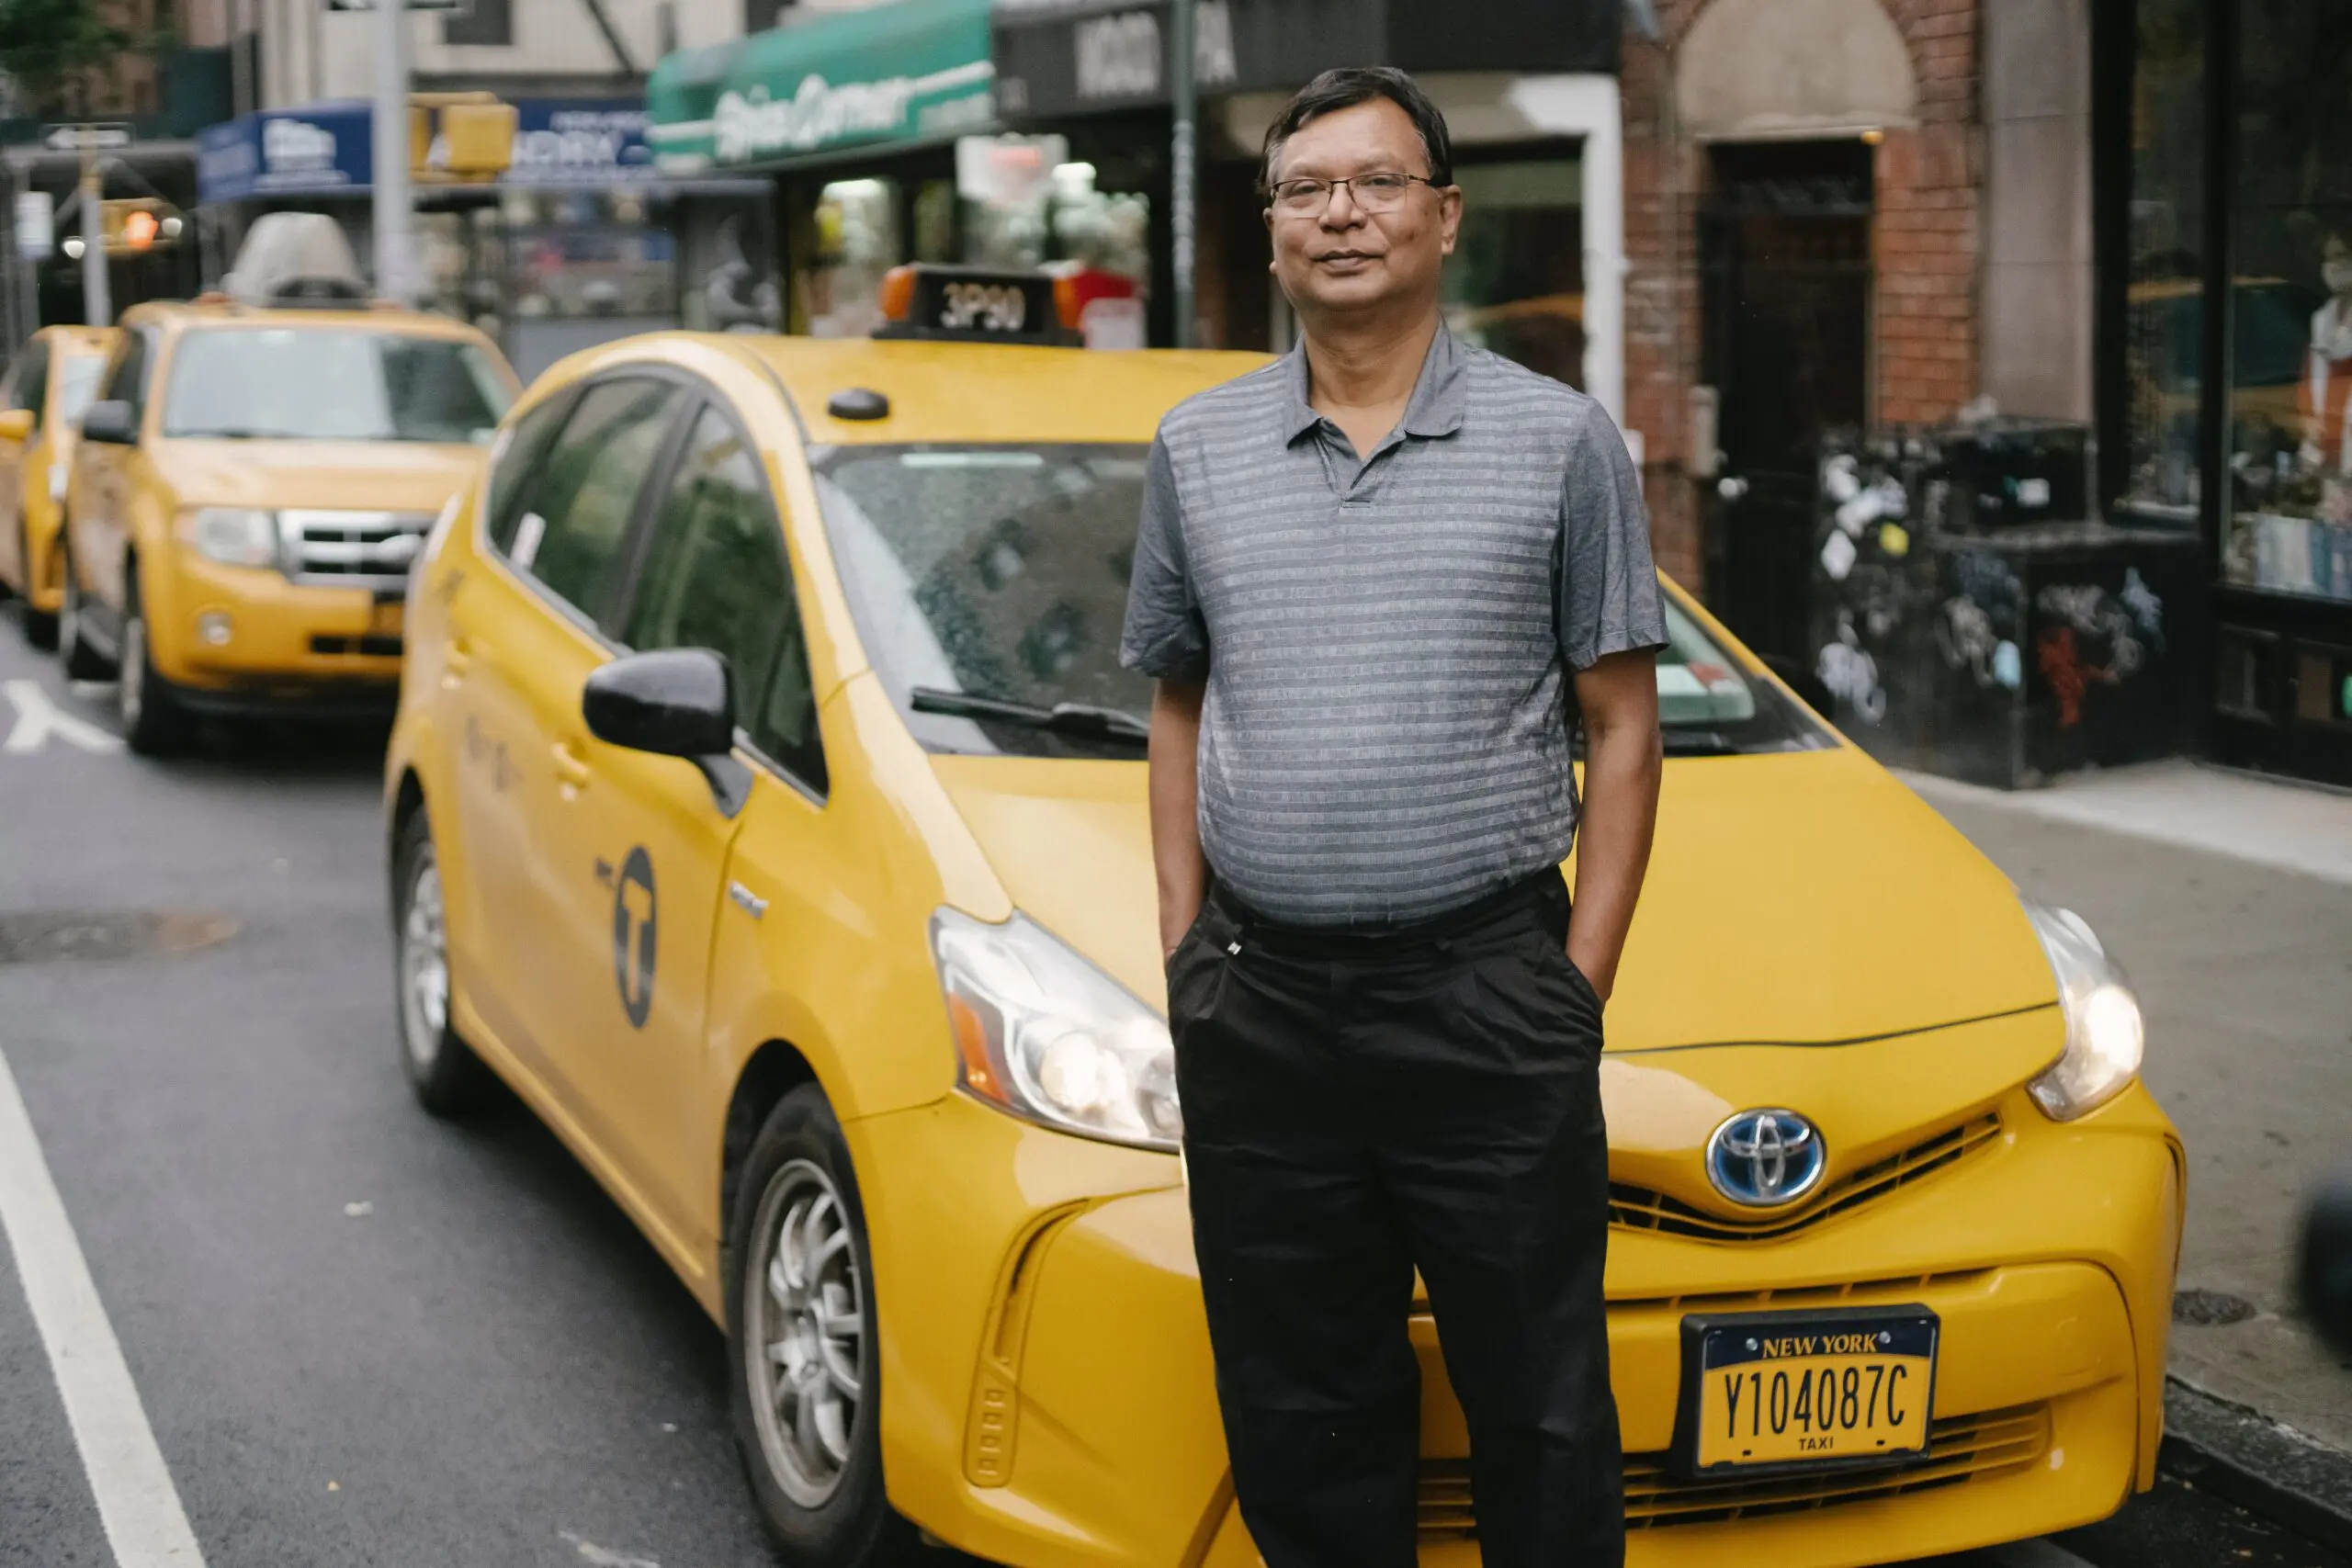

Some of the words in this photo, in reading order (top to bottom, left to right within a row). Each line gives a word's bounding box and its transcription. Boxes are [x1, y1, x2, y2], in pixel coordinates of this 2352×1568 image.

[1762, 1336, 1816, 1359] NEW
[1821, 1334, 1878, 1355] YORK
[1724, 1363, 1907, 1438] Y104087C
[1798, 1437, 1834, 1450] TAXI
